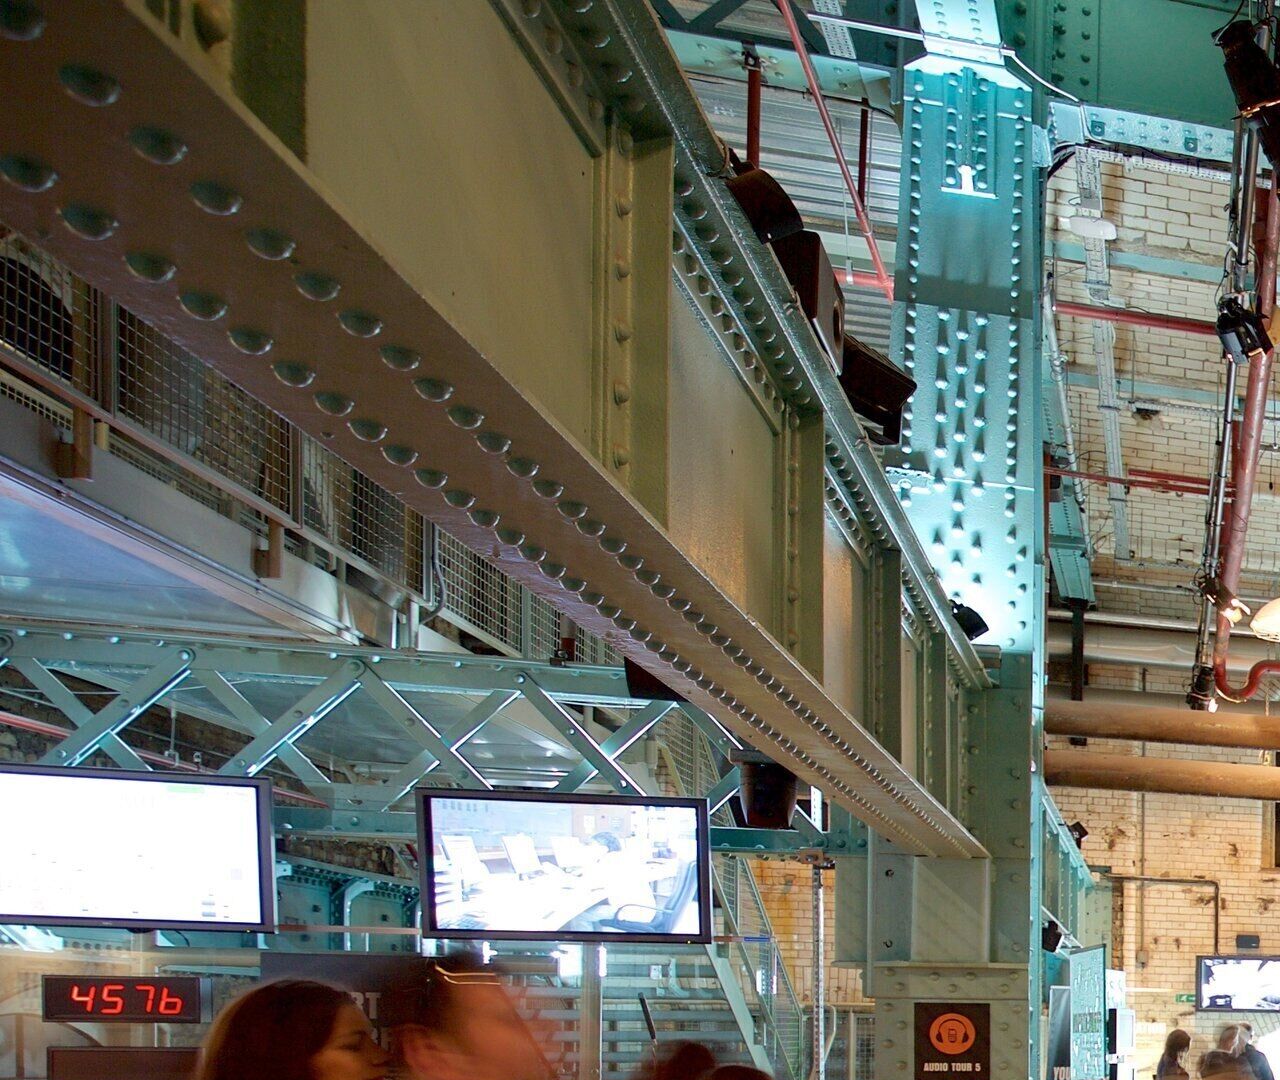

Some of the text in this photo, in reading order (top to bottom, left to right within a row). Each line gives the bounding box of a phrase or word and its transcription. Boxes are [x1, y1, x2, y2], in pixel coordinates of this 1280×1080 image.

[70, 983, 184, 1015] 4576
[923, 1062, 982, 1072] AUDIO TOUR 5
